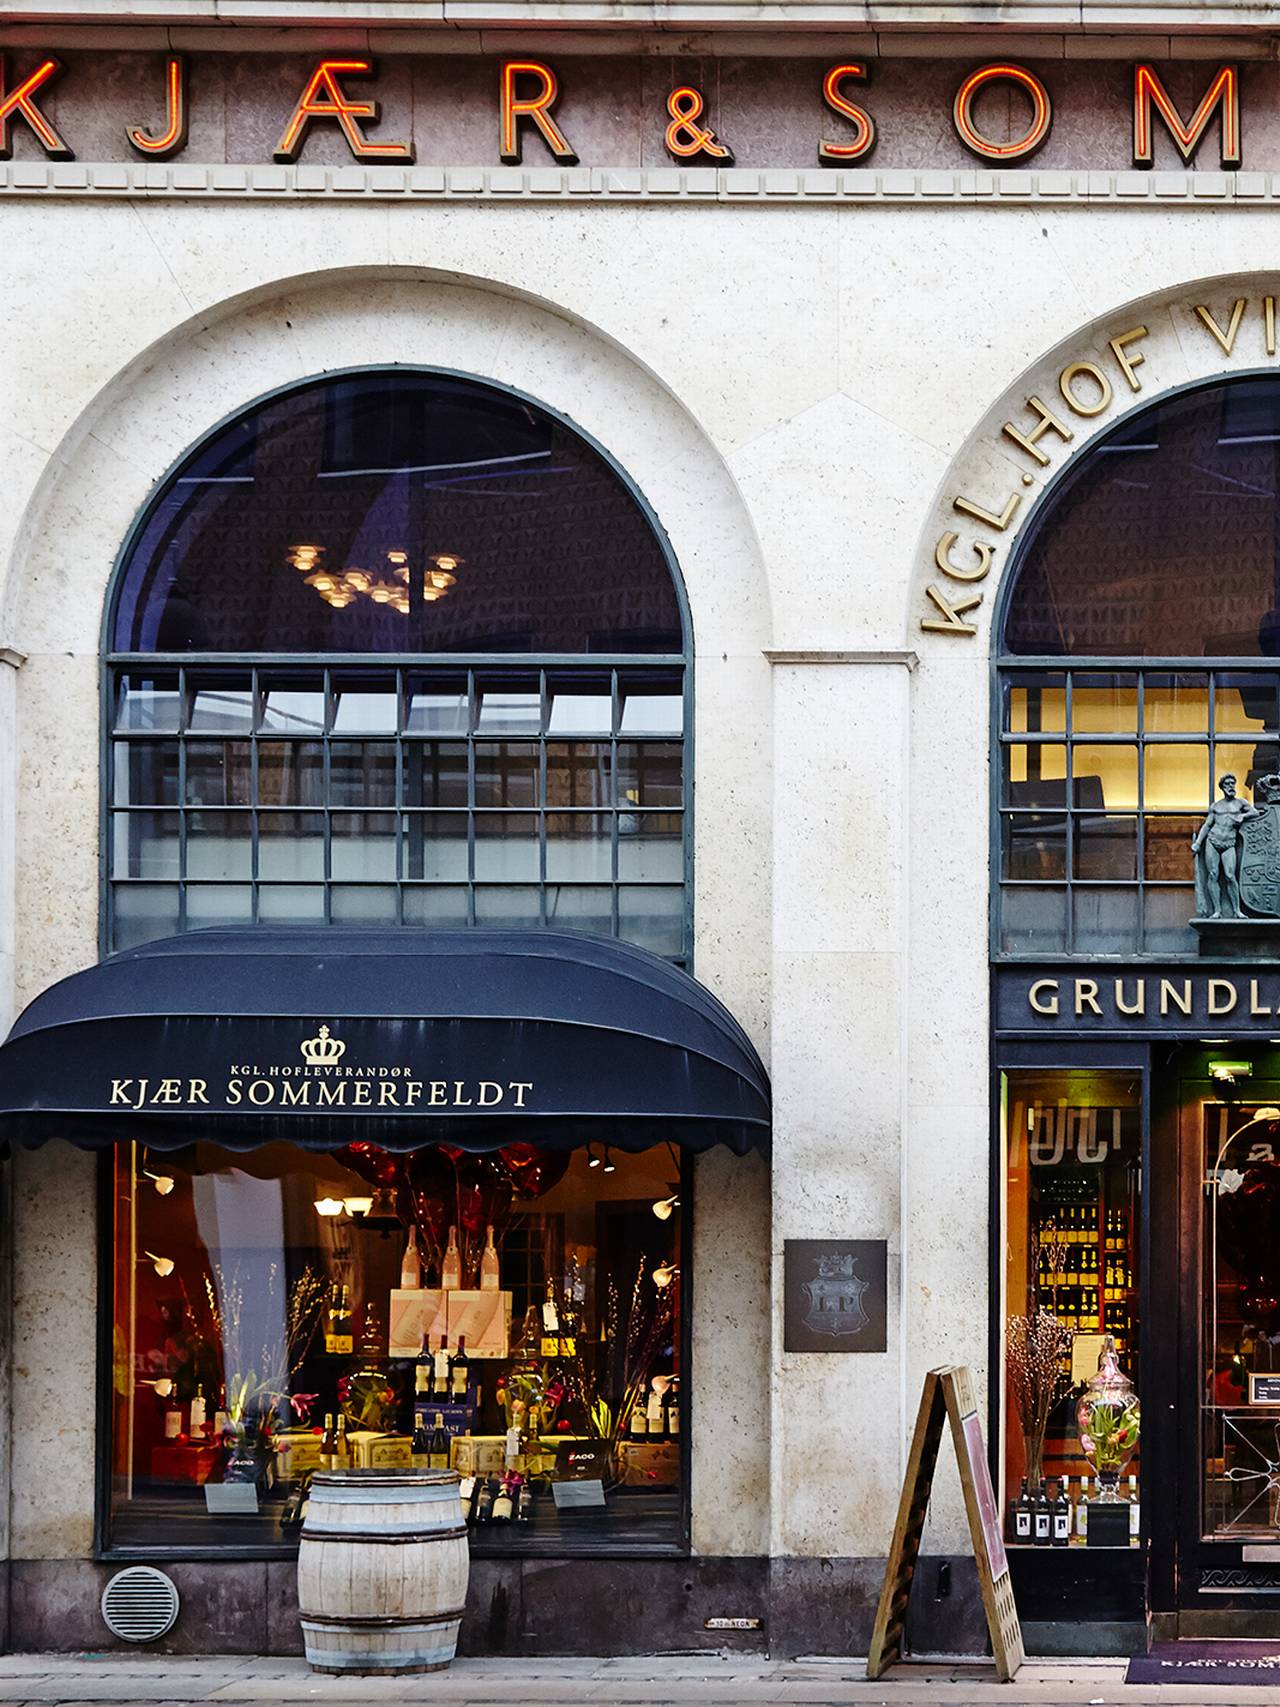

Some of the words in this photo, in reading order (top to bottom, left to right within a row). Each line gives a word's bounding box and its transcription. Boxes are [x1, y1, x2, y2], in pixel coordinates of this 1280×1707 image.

[0, 57, 580, 166] KJÆR
[664, 86, 734, 166] &
[109, 1079, 210, 1110] KJÆR
[226, 1078, 534, 1107] SOMMERFELDT
